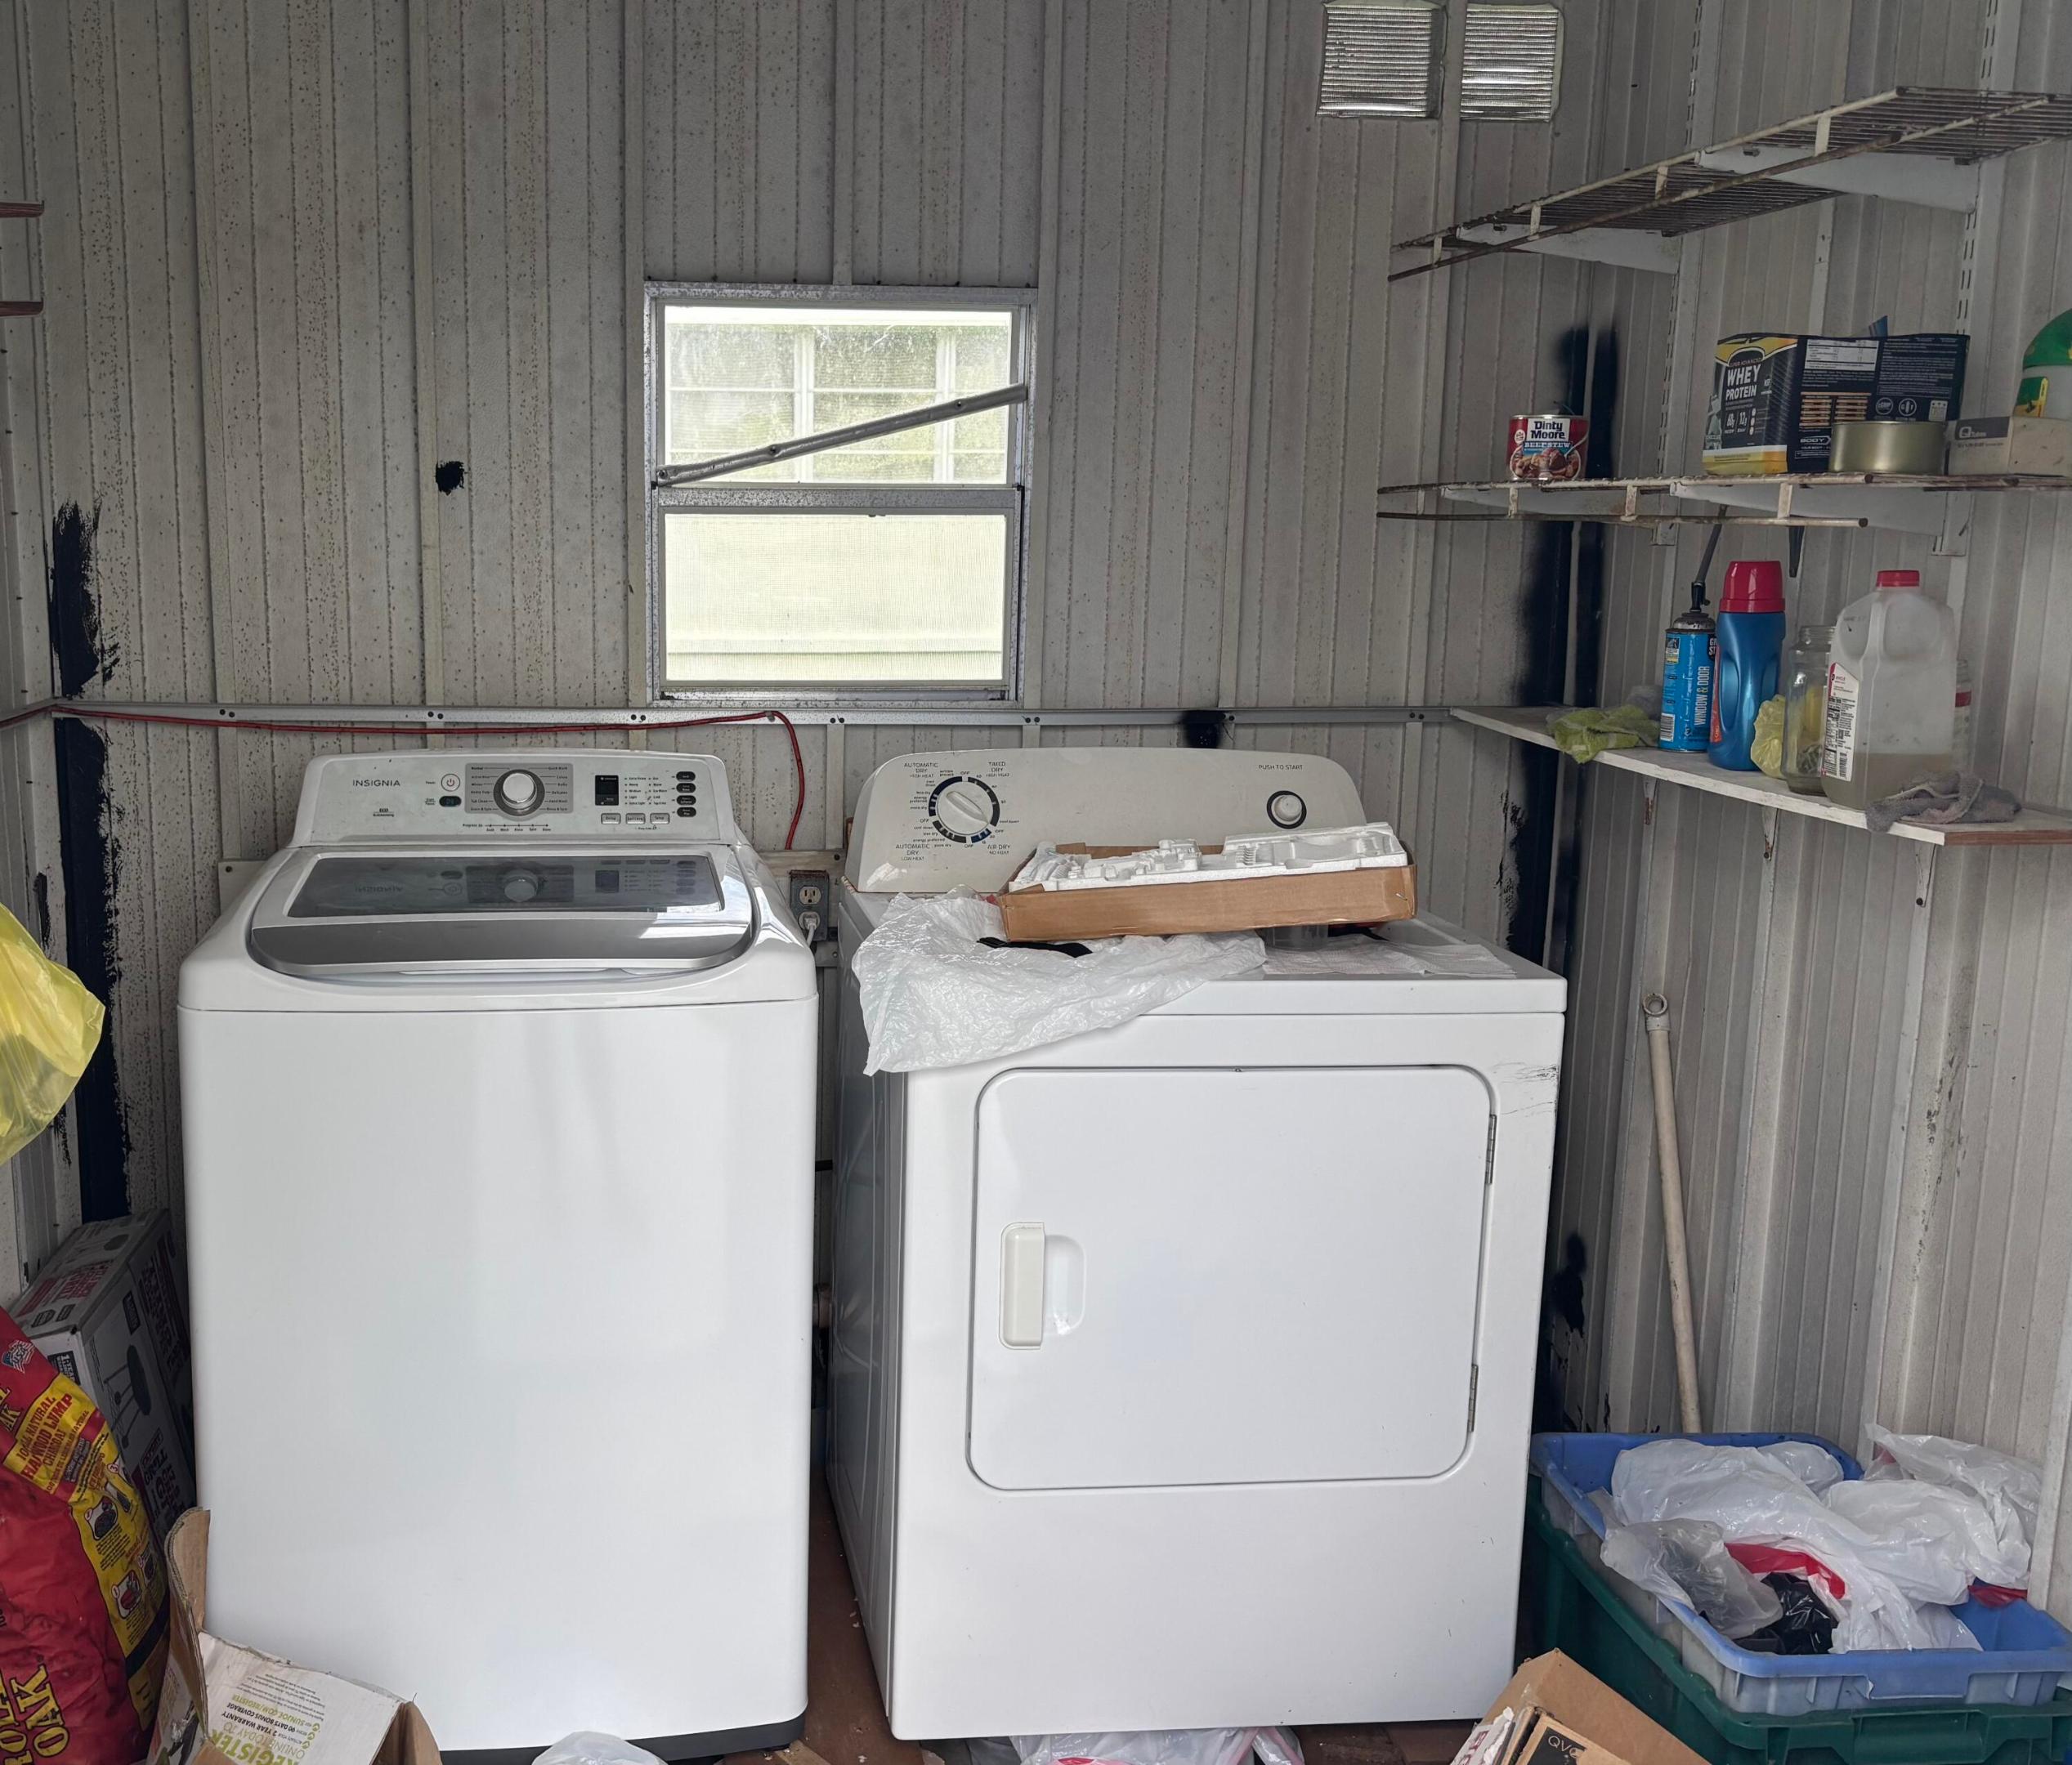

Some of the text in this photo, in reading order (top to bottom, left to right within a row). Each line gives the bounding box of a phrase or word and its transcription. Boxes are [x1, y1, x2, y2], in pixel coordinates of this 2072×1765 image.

[1727, 364, 1761, 387] WHEY
[1725, 385, 1757, 400] PROTEIN
[1531, 431, 1566, 439] Moore
[1534, 421, 1563, 431] Dinty
[1697, 666, 1711, 686] DOOR
[1694, 695, 1708, 726] WINDOW
[11, 1343, 26, 1363] USA
[26, 1396, 56, 1436] NATURAL
[44, 1393, 72, 1429] LUMP
[10, 1663, 70, 1758] OAK
[227, 1702, 254, 1718] COVERAGE
[255, 1714, 274, 1725] BONUS
[222, 1711, 256, 1730] WARRANTY
[275, 1721, 289, 1730] DAYS
[223, 1722, 305, 1758] ONLINE TODAY TO
[257, 1726, 271, 1736] YEAR
